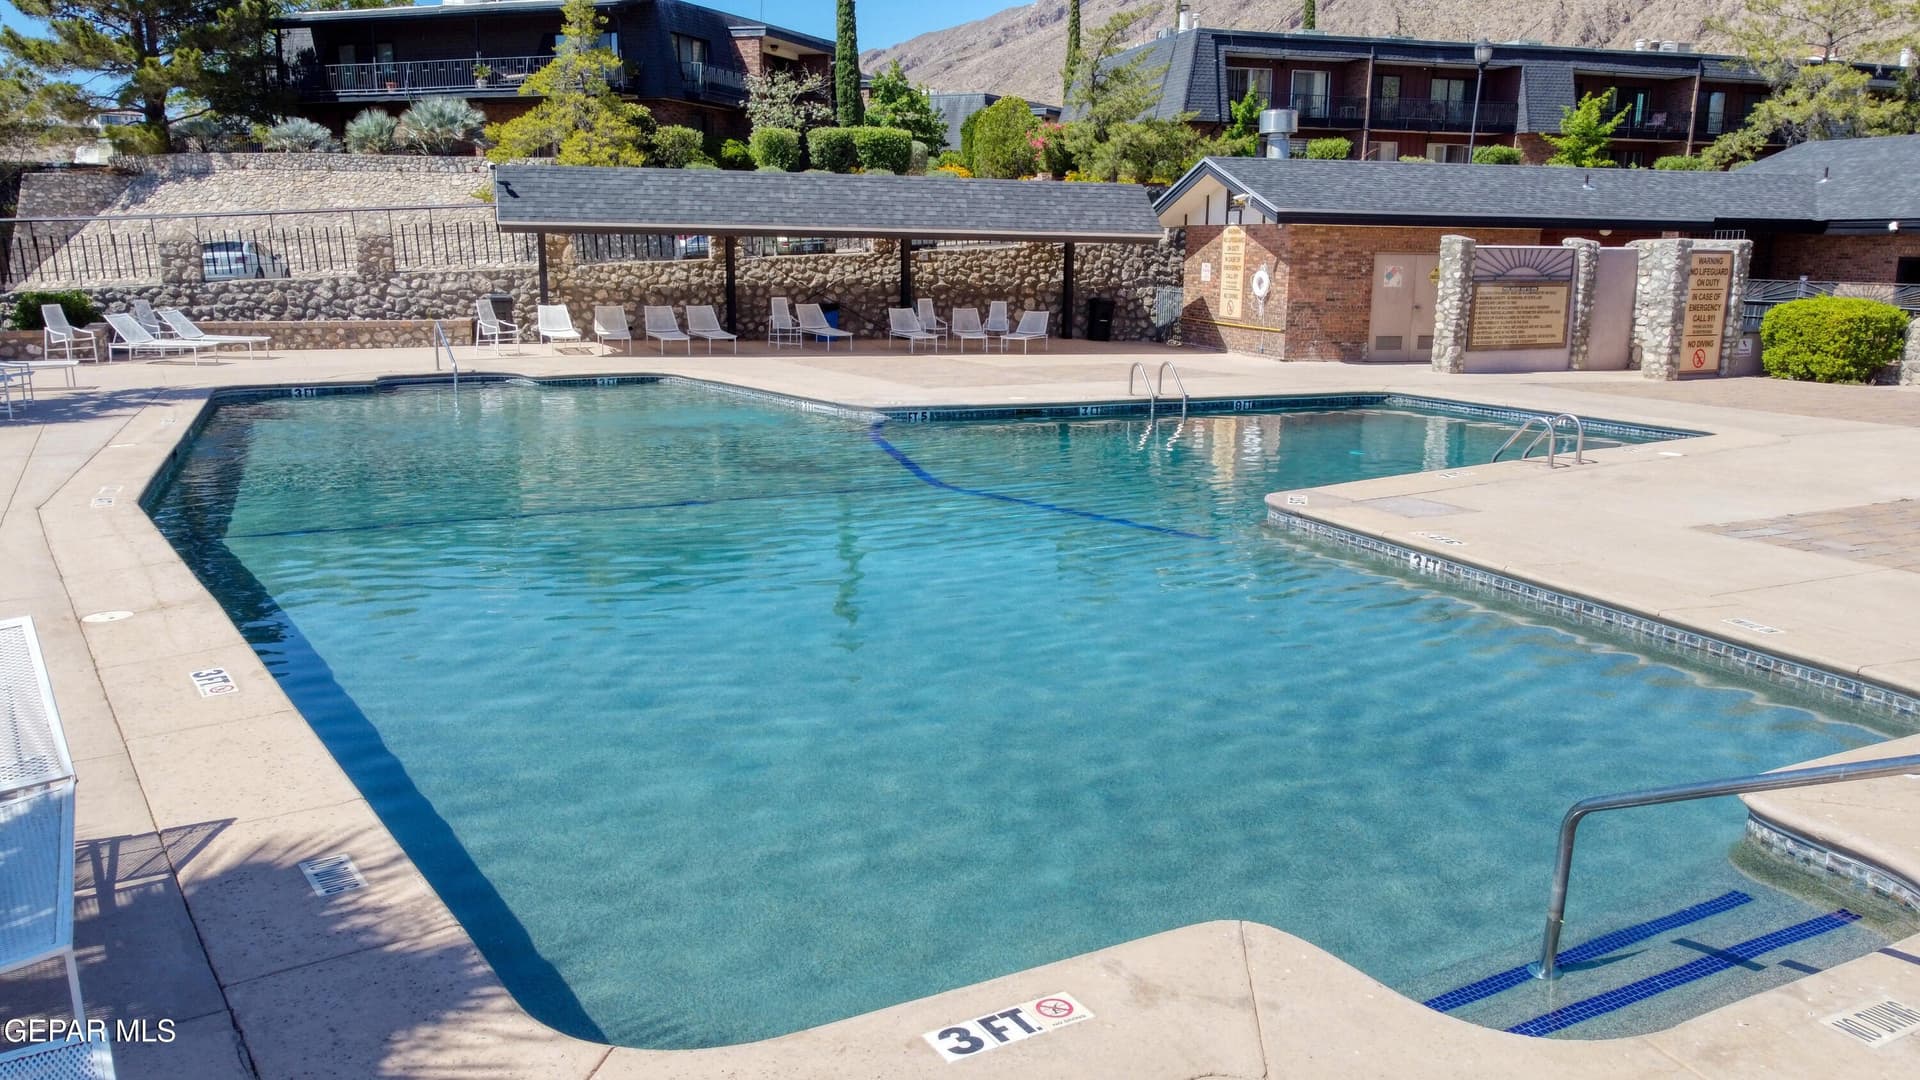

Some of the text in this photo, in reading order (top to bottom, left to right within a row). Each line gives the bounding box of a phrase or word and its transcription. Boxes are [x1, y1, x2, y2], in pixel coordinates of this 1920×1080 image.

[1699, 256, 1724, 265] WARNING
[1696, 279, 1720, 287] ON DUTY
[1692, 293, 1722, 301] IN CASE OF
[1688, 304, 1721, 312] EMERGENCY
[1692, 314, 1716, 322] CALL 911
[1688, 340, 1696, 348] NO
[938, 1007, 1043, 1055] 3 FT.
[1832, 1017, 1882, 1043] NO
